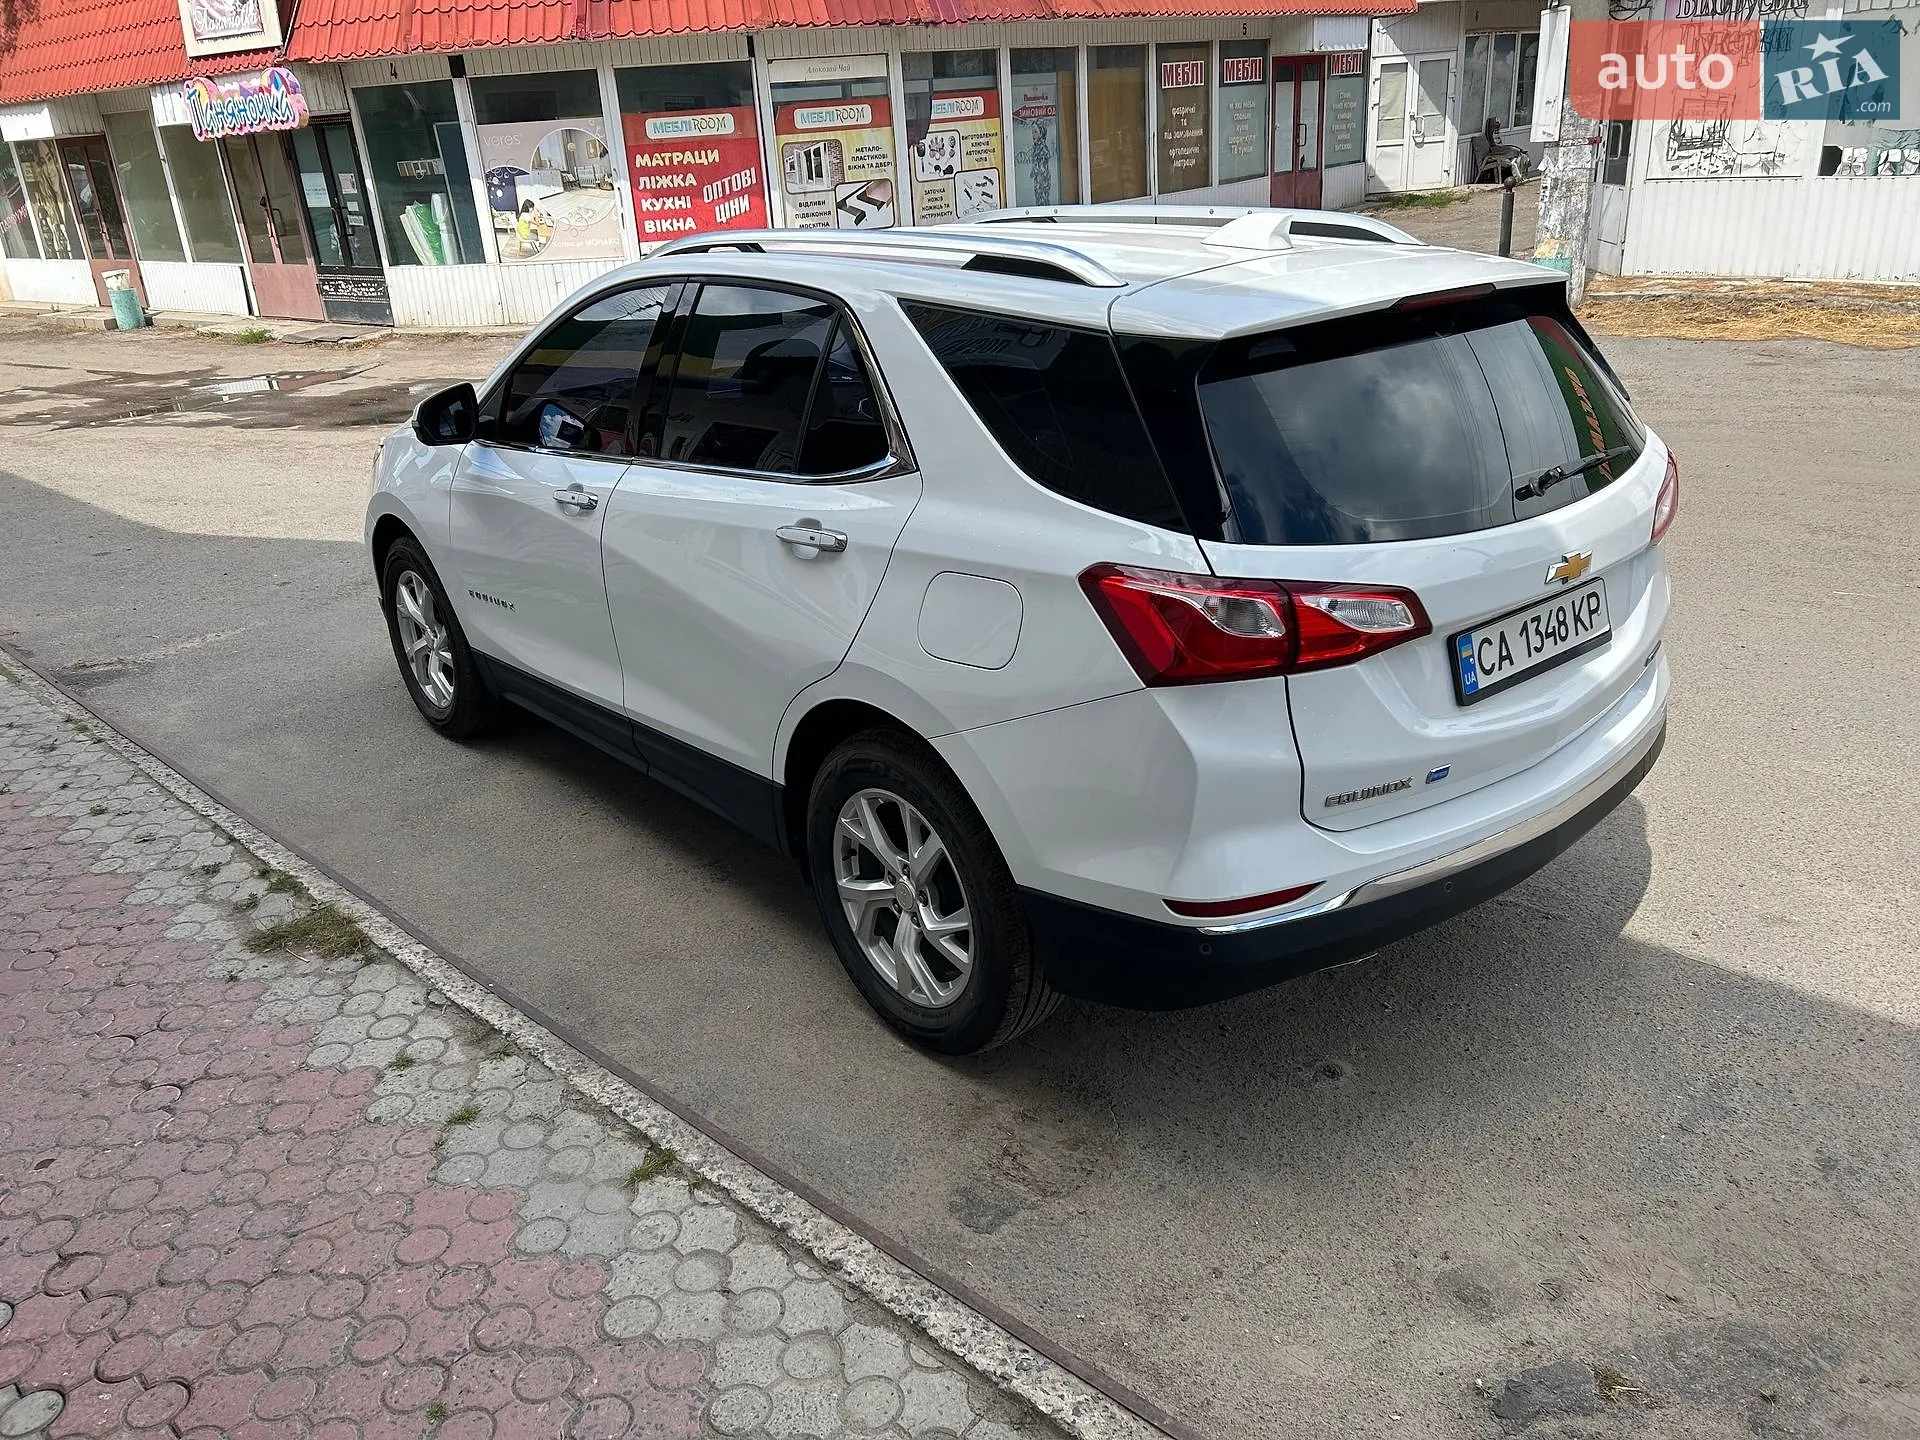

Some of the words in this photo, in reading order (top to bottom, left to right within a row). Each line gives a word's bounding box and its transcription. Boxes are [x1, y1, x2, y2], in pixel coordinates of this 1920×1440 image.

[1242, 23, 1247, 36] 5
[389, 62, 398, 79] 4
[1224, 57, 1263, 83] МЕБЛІ
[1331, 52, 1363, 75] МЕБЛІ
[1162, 61, 1204, 88] МЕБЛІ
[187, 84, 294, 134] Паняночка
[851, 153, 888, 161] ПЛАСТИКОВІ
[855, 145, 883, 153] МЕТАЛО-
[635, 148, 720, 168] МАТРАЦИ
[875, 161, 892, 169] ДВЕРІ
[638, 173, 697, 190] ЛІЖКА
[703, 166, 757, 203] ОПТОВІ
[924, 187, 946, 195] ЗАТОЧКА
[641, 195, 691, 212] КУХНІ
[714, 194, 751, 223] ЦІНИ
[798, 200, 826, 208] ВІДЛИВИ
[795, 211, 832, 219] ПІДВІКОННЯ
[644, 217, 697, 234] ВІКНА
[1477, 630, 1514, 676] CA
[1519, 605, 1569, 657] 1348
[1571, 591, 1601, 637] KP
[1464, 673, 1477, 685] UA
[1324, 776, 1413, 808] EQUINOX
